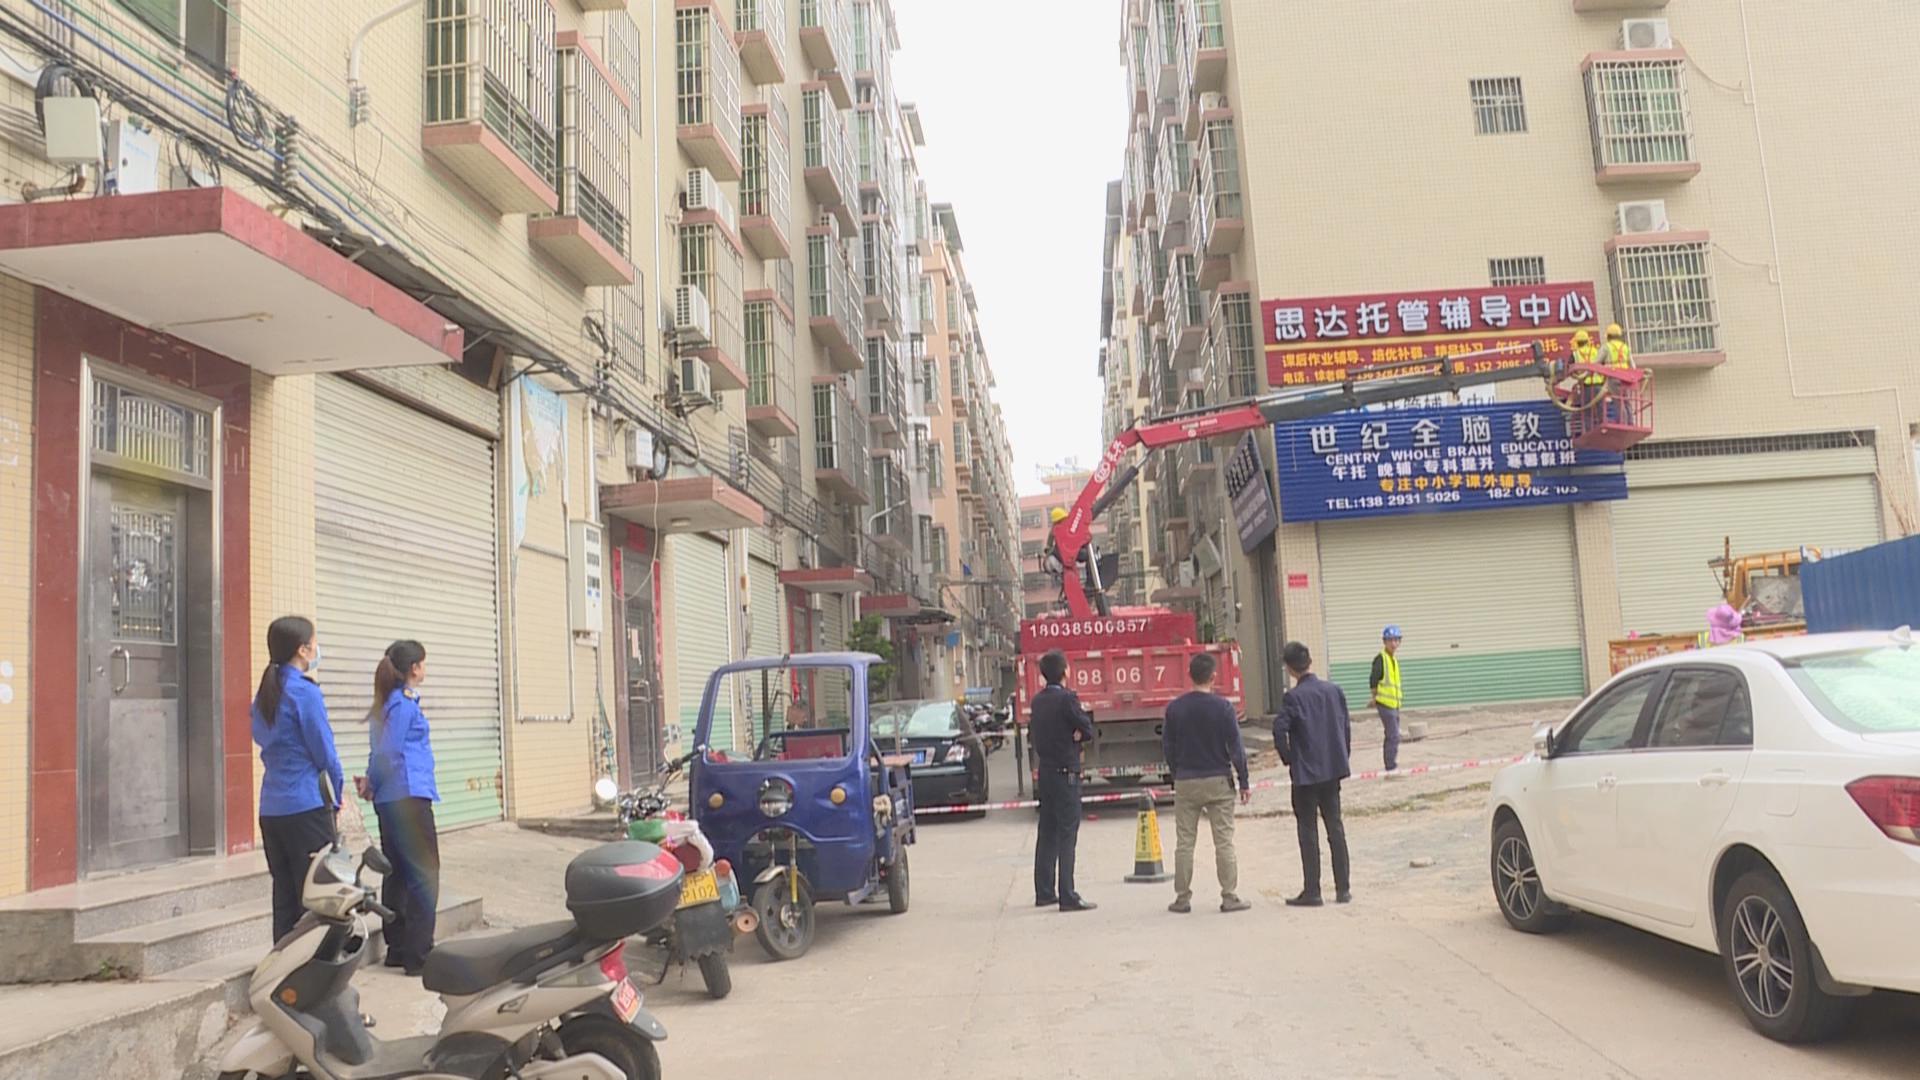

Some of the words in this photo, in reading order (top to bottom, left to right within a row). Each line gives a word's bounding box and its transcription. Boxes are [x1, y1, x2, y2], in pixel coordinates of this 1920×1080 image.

[1274, 290, 1594, 341] 思达托管辅导中心
[1325, 452, 1380, 466] CENTRY
[1391, 447, 1441, 461] WHOLE
[1447, 444, 1492, 457] BRAIN
[1332, 464, 1367, 481] 午托
[1388, 493, 1421, 507] 2931
[1425, 490, 1461, 503] 5026
[1030, 617, 1147, 638] 18038500857
